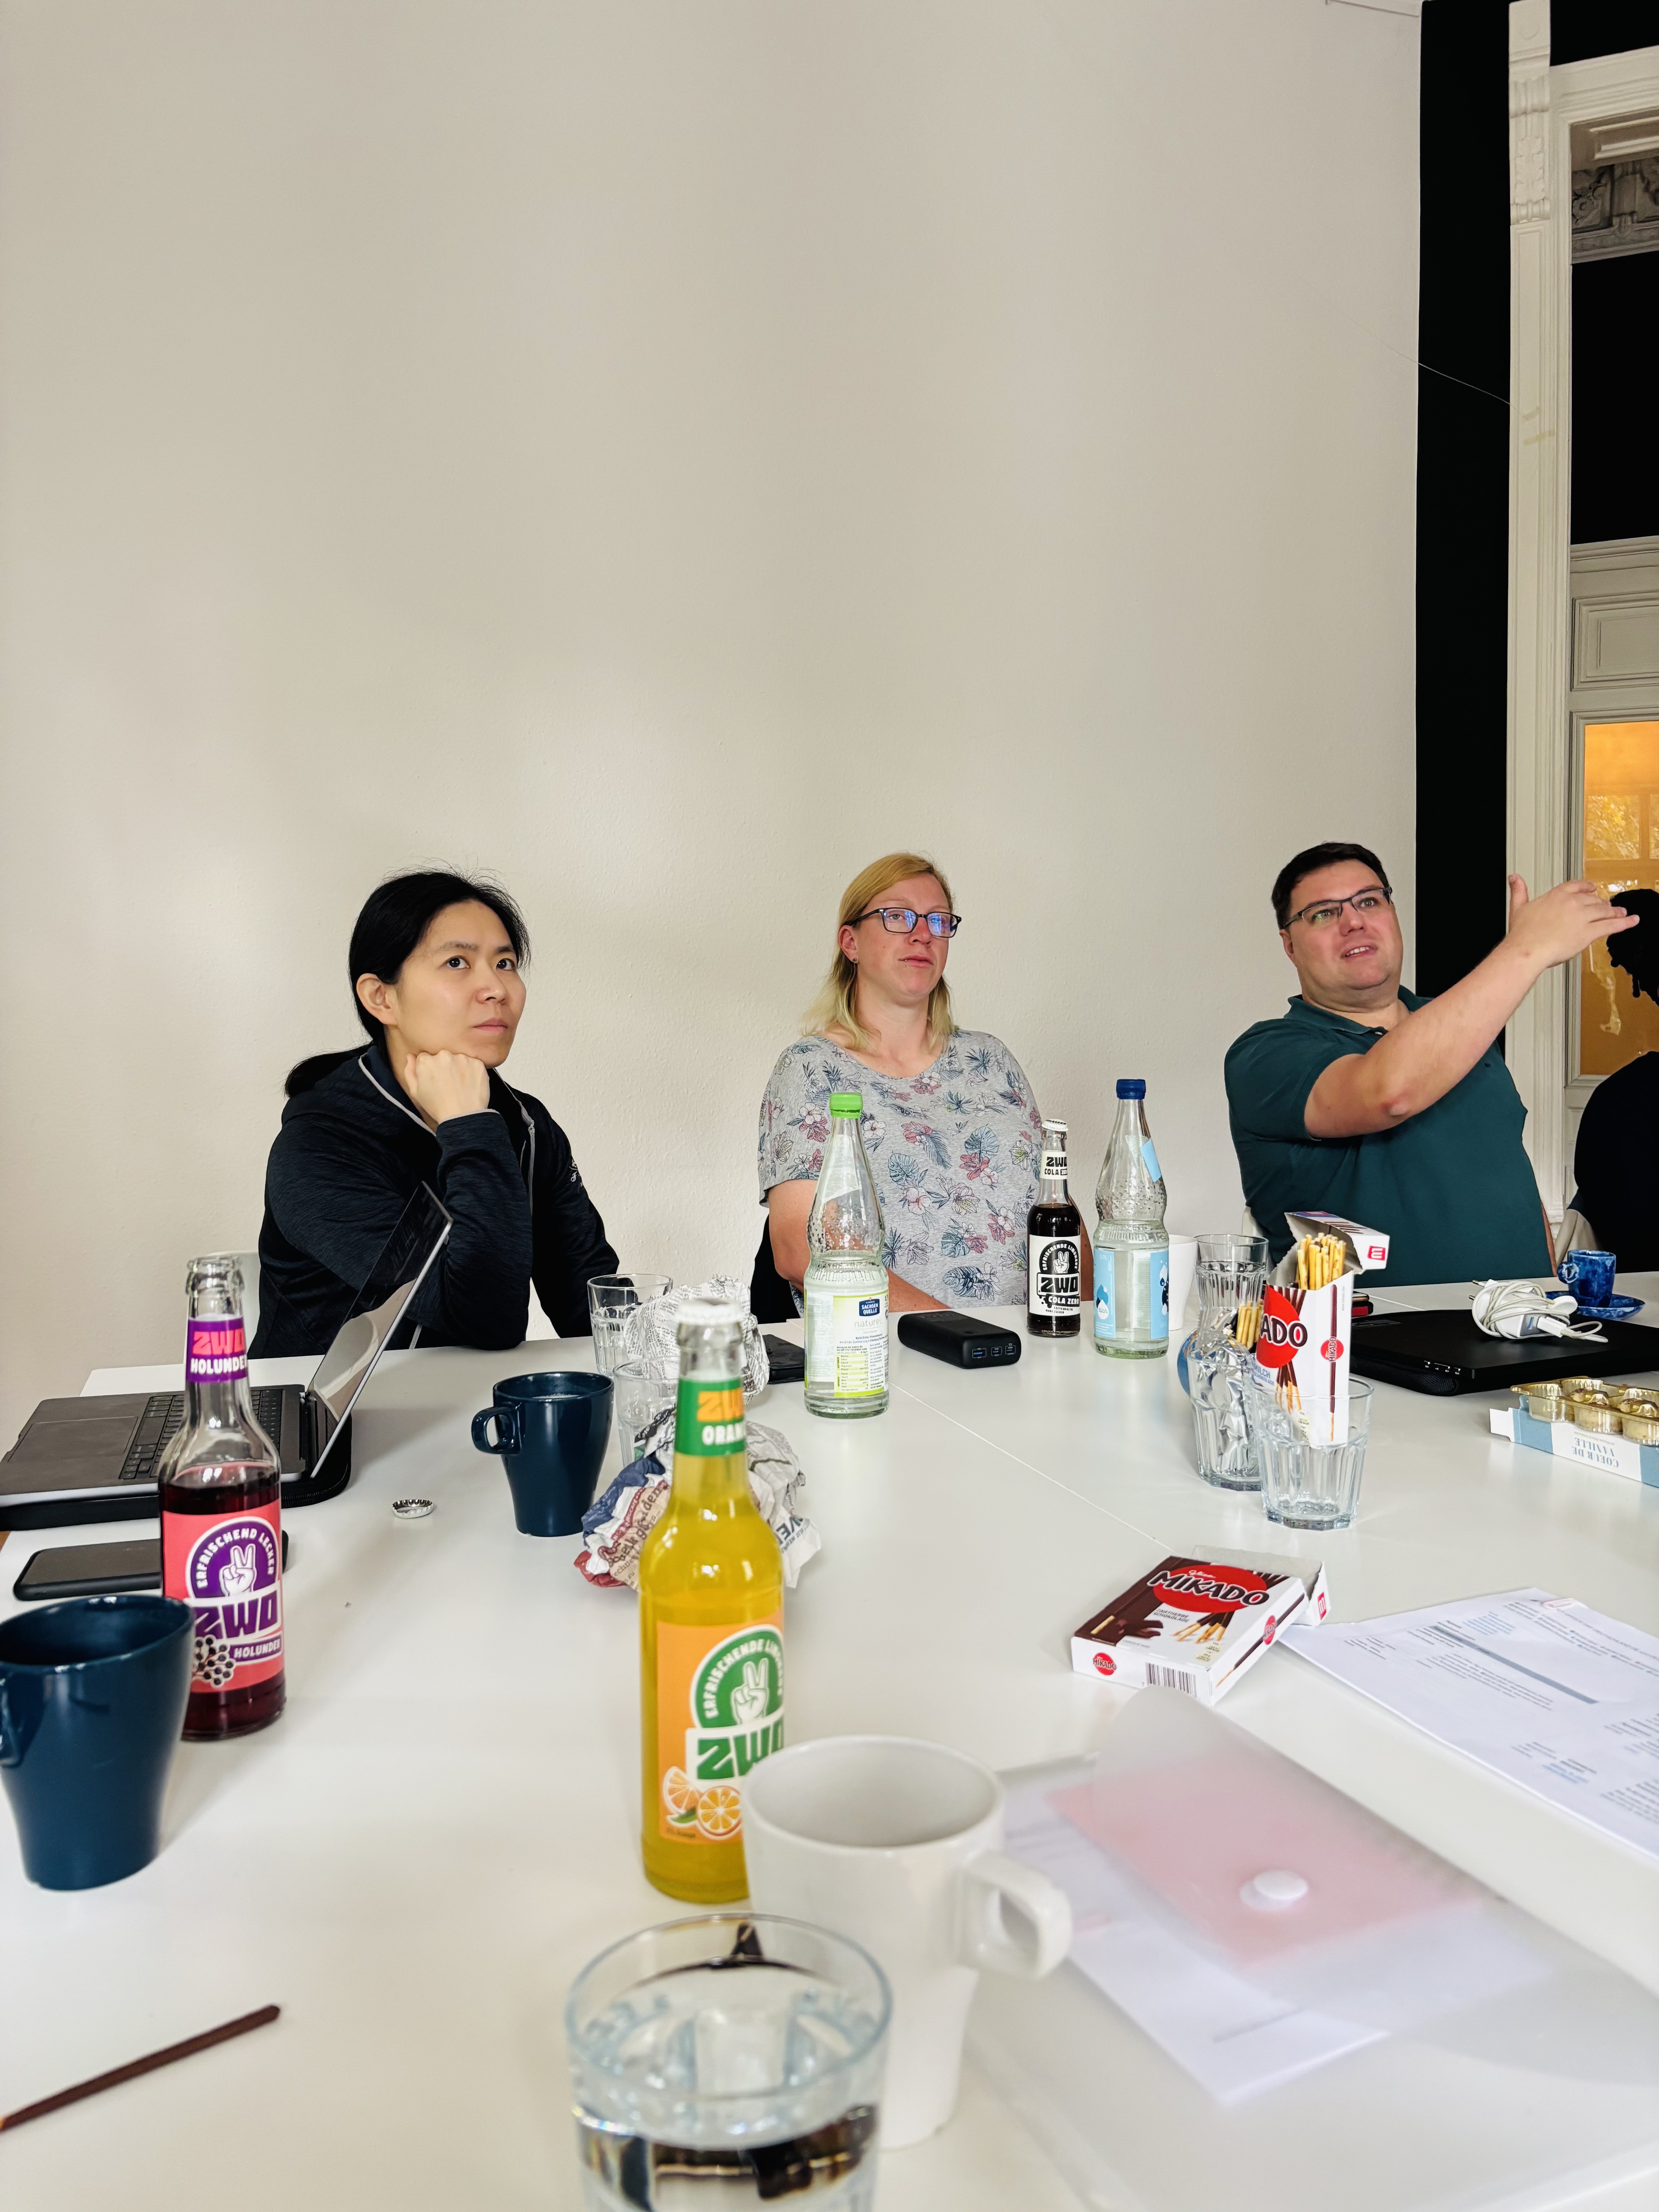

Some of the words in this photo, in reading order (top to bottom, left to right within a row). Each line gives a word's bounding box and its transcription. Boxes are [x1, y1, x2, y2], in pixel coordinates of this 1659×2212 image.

[1046, 1156, 1067, 1167] ZWO
[1042, 1243, 1067, 1271] ERFRISCHENDE
[1041, 1276, 1078, 1293] ZWO
[1048, 1296, 1066, 1304] COLA
[854, 1317, 883, 1328] naturell
[192, 1328, 246, 1355] ZWO
[1328, 1336, 1337, 1363] MIKADO
[1572, 1446, 1584, 1458] DE
[1575, 1437, 1614, 1457] VANILLE
[1587, 1450, 1619, 1468] COEUR
[196, 1528, 258, 1589] ERFRISCHEND
[258, 1532, 276, 1575] LECKER
[1146, 1570, 1270, 1606] MIKADO
[195, 1589, 278, 1640] ZWO
[1153, 1612, 1190, 1623] SCHOKOLADE
[1156, 1609, 1190, 1618] ZARTHERBE
[233, 1638, 281, 1659] HOLUNDER
[1092, 1657, 1117, 1671] MIKADO
[703, 1638, 764, 1719] ERFRISCHENDE
